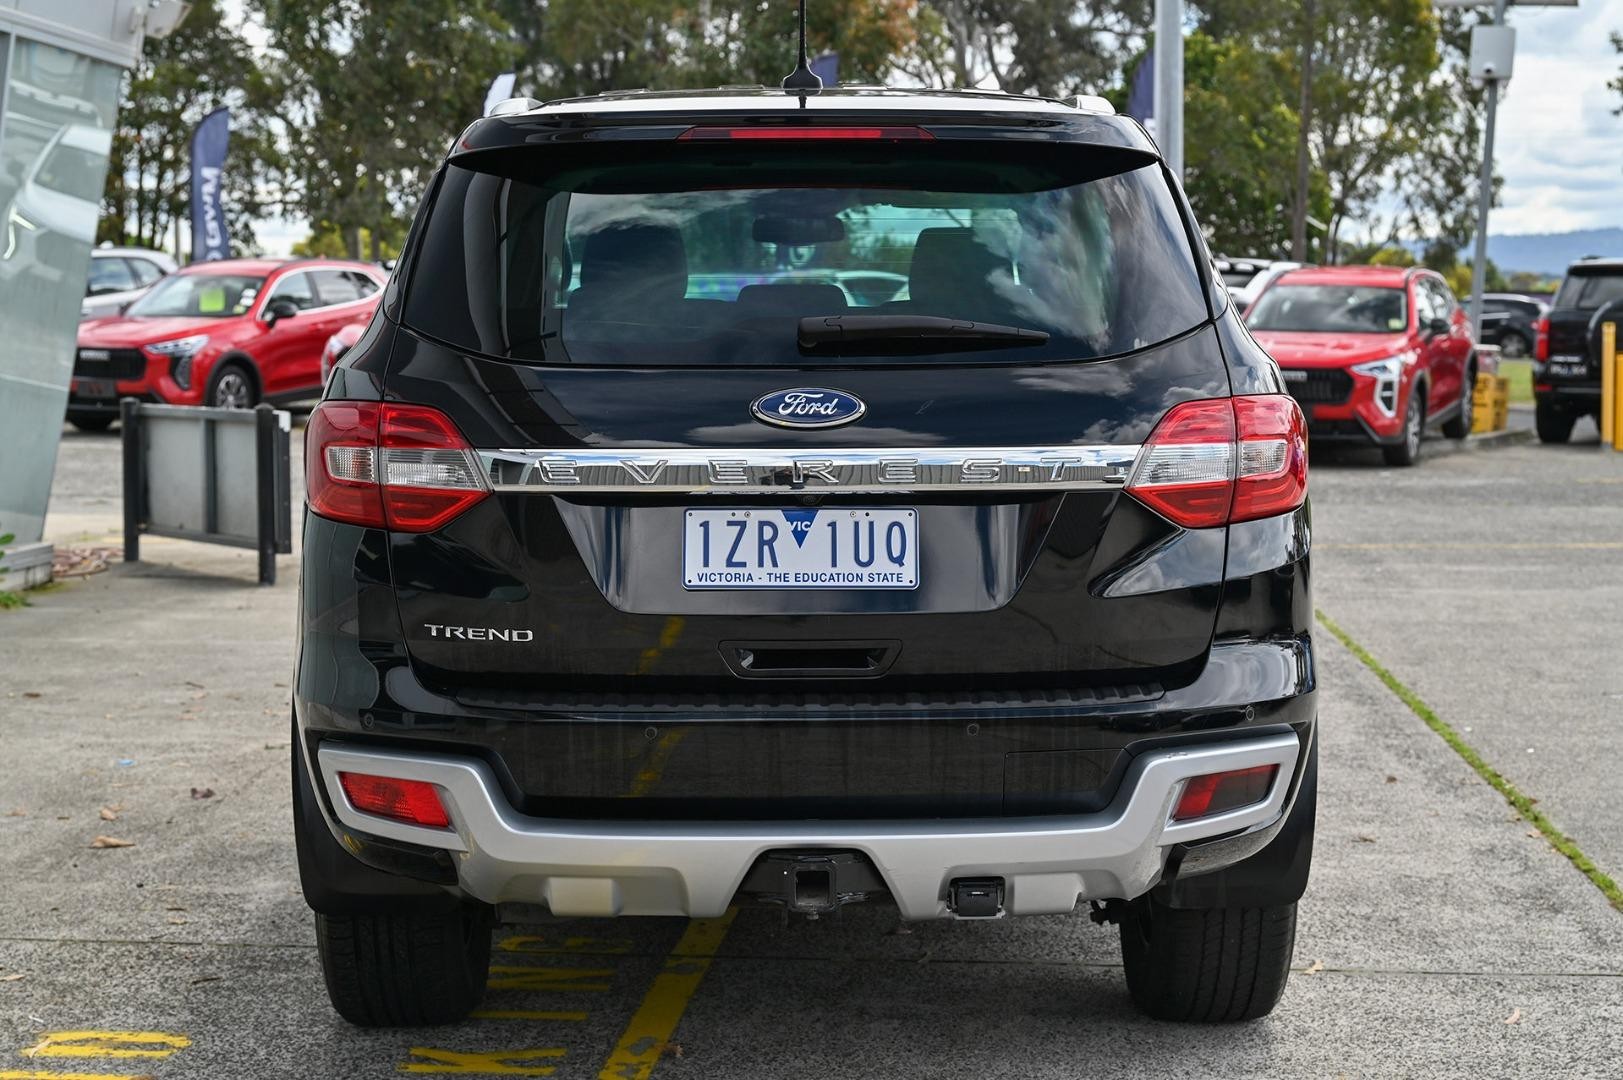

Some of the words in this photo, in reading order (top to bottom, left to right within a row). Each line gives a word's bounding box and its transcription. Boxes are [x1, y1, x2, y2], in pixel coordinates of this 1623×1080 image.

[778, 392, 839, 415] Ford
[538, 456, 1082, 484] EVEREST
[787, 520, 811, 532] VIC
[699, 520, 779, 568] 1ZR
[827, 520, 907, 568] 1UQ
[697, 572, 754, 583] VICTORIA
[767, 572, 790, 583] THE
[794, 572, 864, 583] EDUCATION
[868, 572, 904, 583] STATE
[424, 624, 533, 642] TREND
